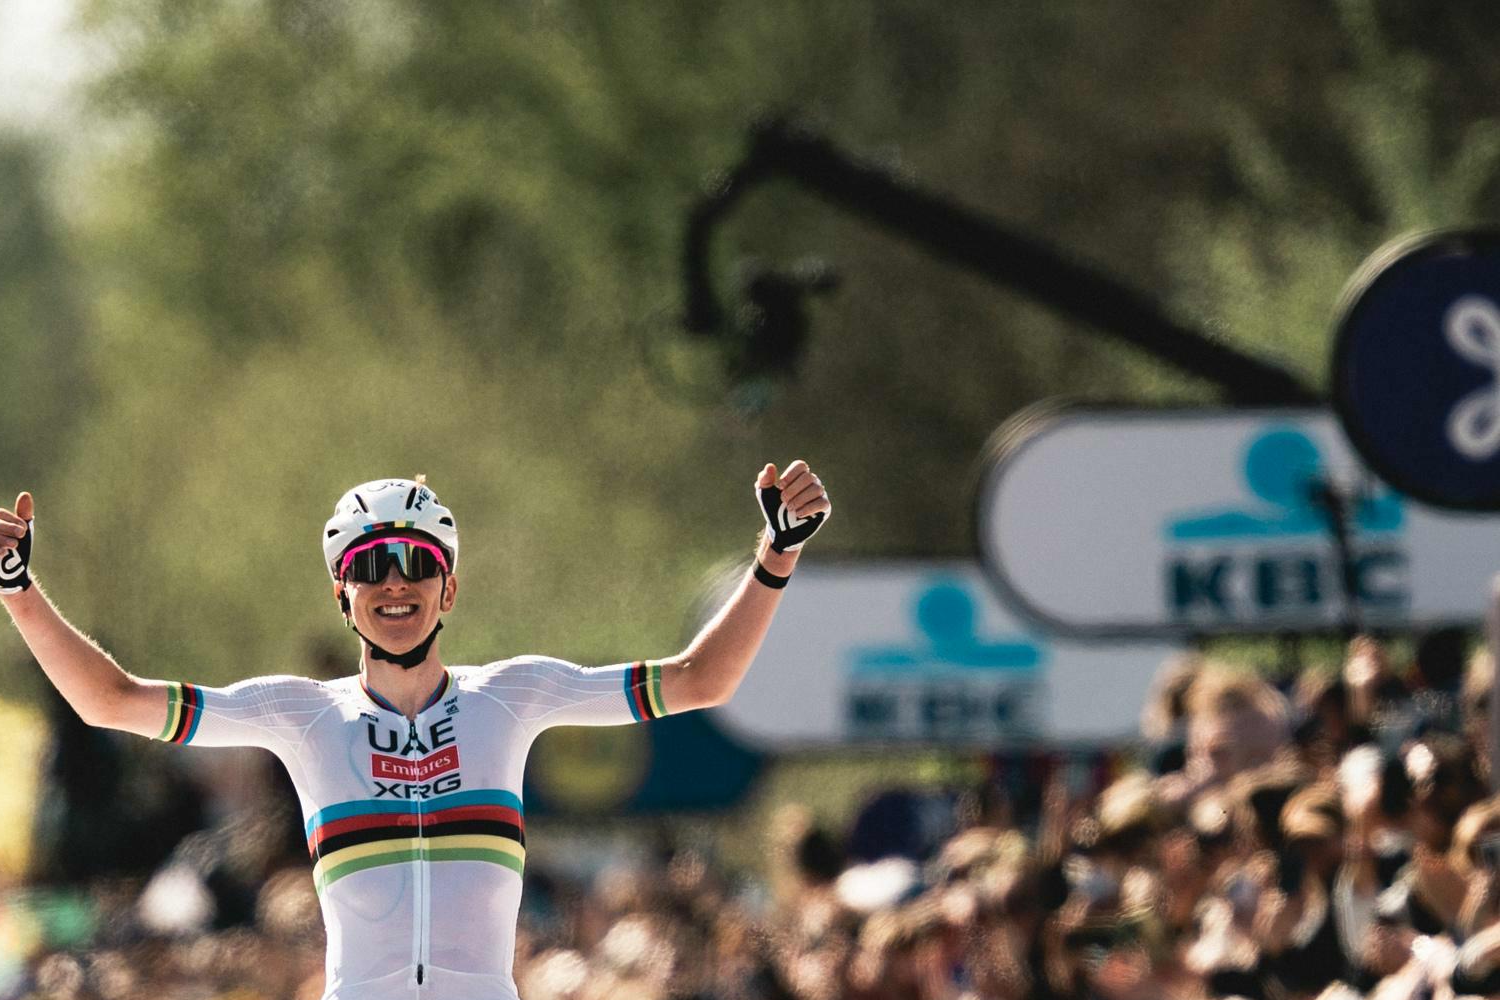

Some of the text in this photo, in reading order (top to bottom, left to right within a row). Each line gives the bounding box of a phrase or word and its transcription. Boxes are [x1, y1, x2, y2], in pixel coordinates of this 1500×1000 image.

[1164, 550, 1412, 622] KBC
[368, 716, 456, 756] UAE
[373, 772, 461, 799] XRG
